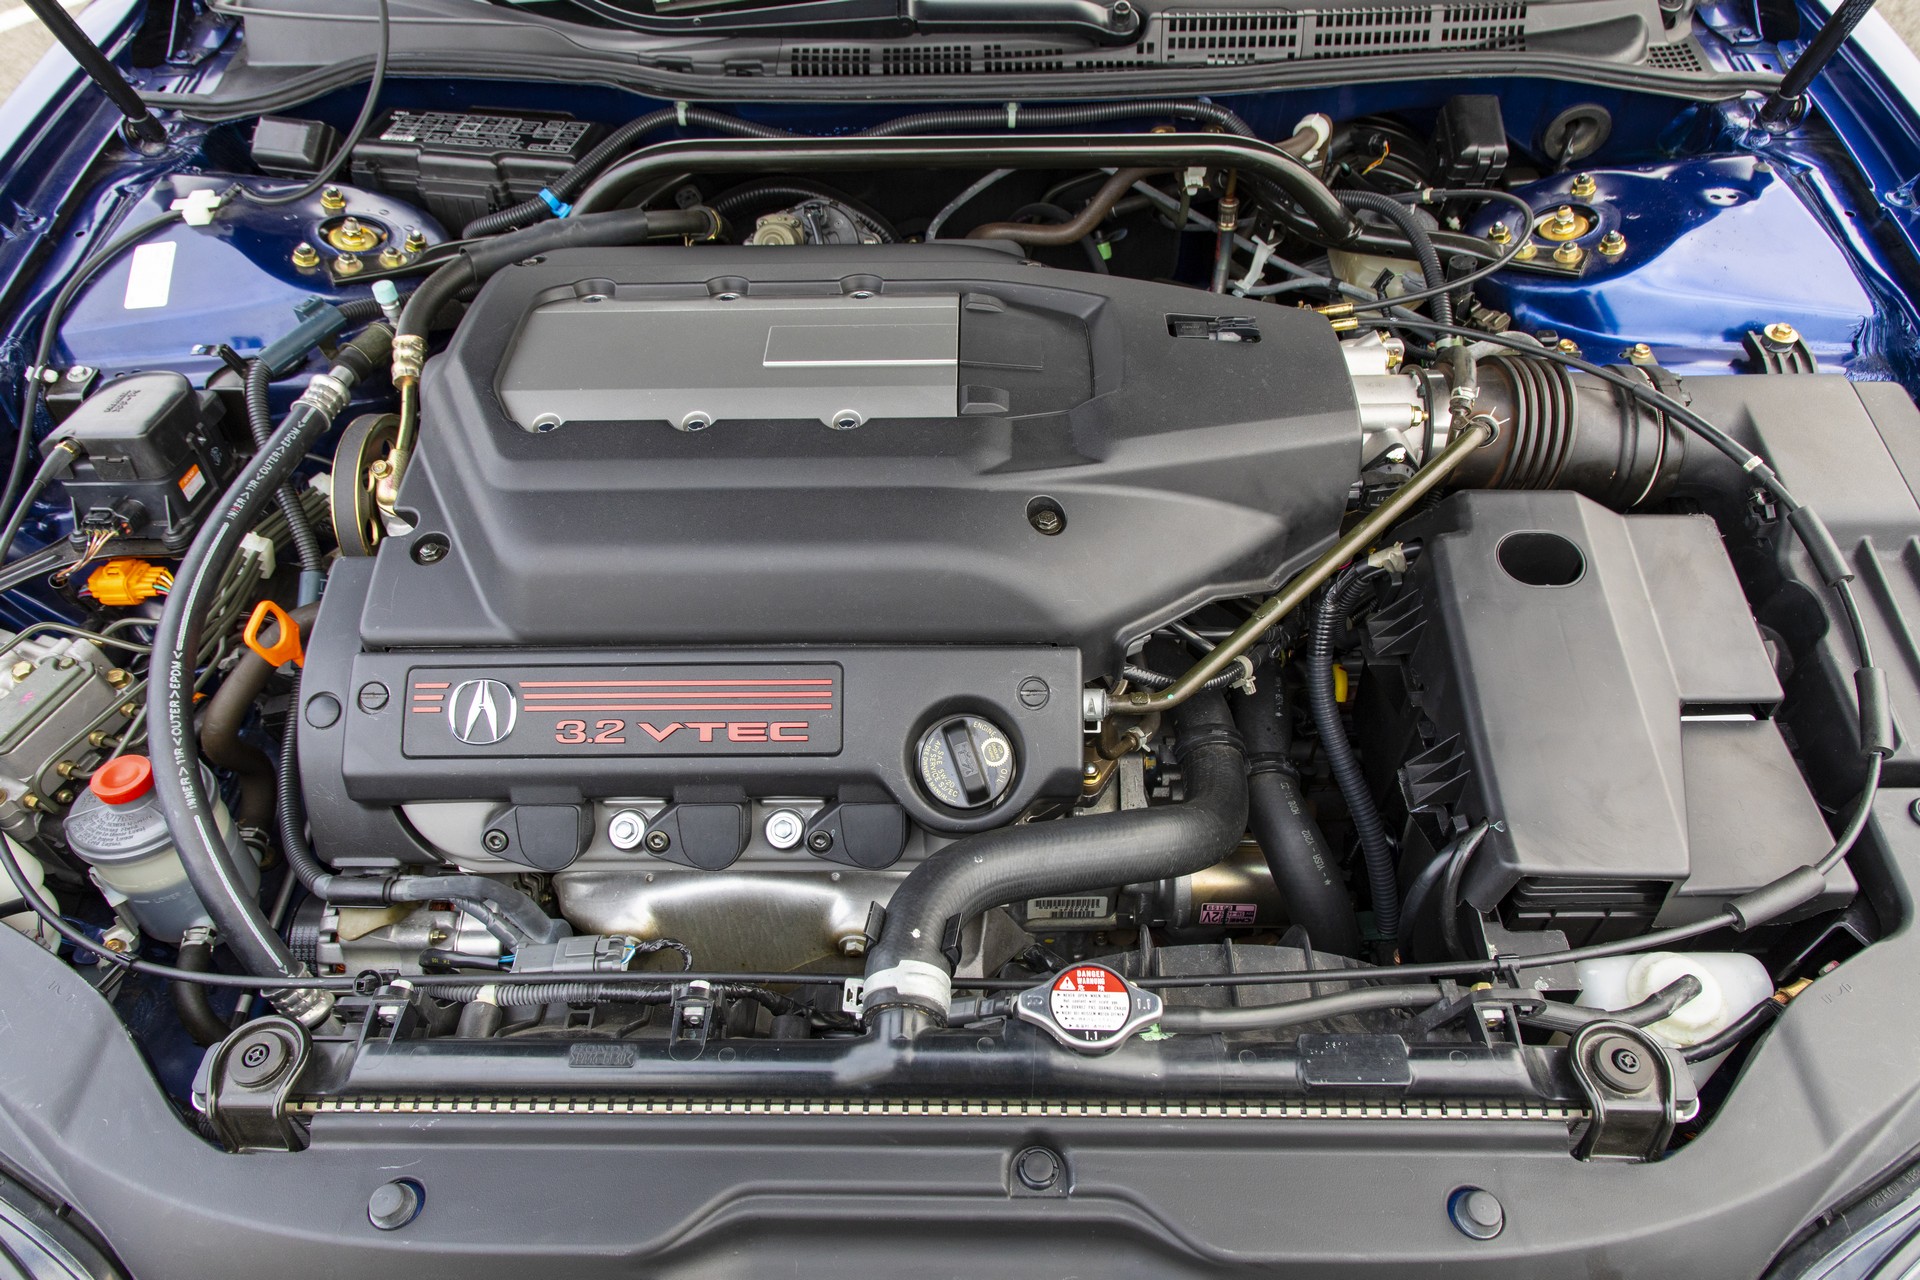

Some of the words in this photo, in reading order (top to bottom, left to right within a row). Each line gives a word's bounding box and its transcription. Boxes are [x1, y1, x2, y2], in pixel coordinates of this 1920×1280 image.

[555, 719, 626, 744] 3.2
[636, 721, 809, 743] VTEC
[973, 721, 997, 738] ENGINE
[996, 768, 1008, 783] OIL
[929, 753, 940, 782] SERVICE
[938, 768, 955, 788] 5W-20
[1136, 998, 1151, 1010] 1.1
[1084, 1031, 1098, 1041] 1.1
